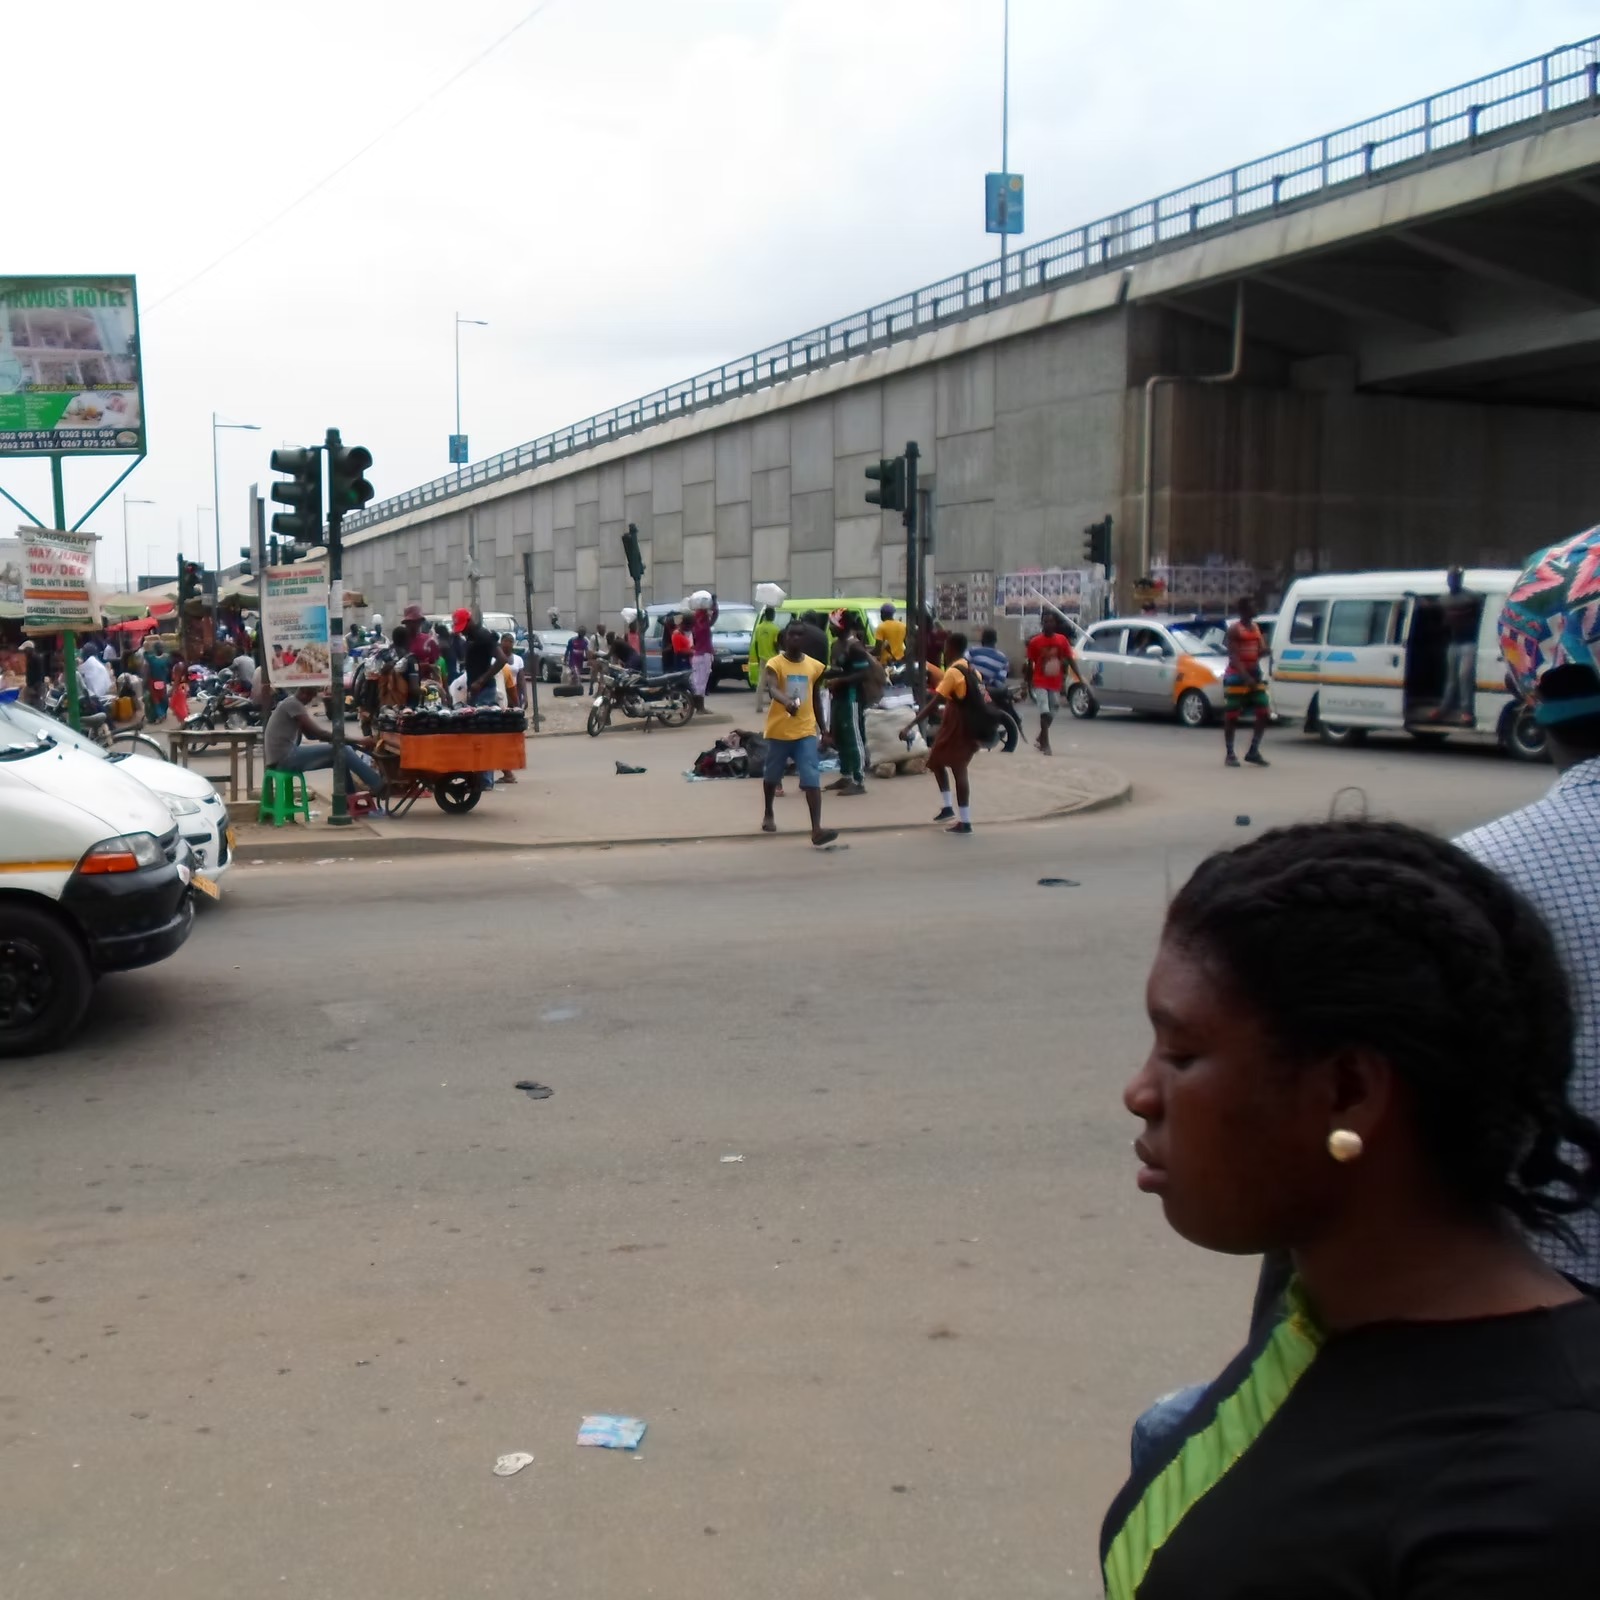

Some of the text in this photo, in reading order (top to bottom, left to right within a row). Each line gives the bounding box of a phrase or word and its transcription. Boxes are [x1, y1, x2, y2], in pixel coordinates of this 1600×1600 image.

[72, 288, 127, 307] HOTEL
[18, 431, 33, 440] 999
[35, 431, 50, 439] 241
[81, 430, 96, 438] 861
[20, 441, 35, 449] 321
[38, 440, 53, 448] 115
[61, 440, 81, 448] 0267
[101, 439, 116, 447] 242
